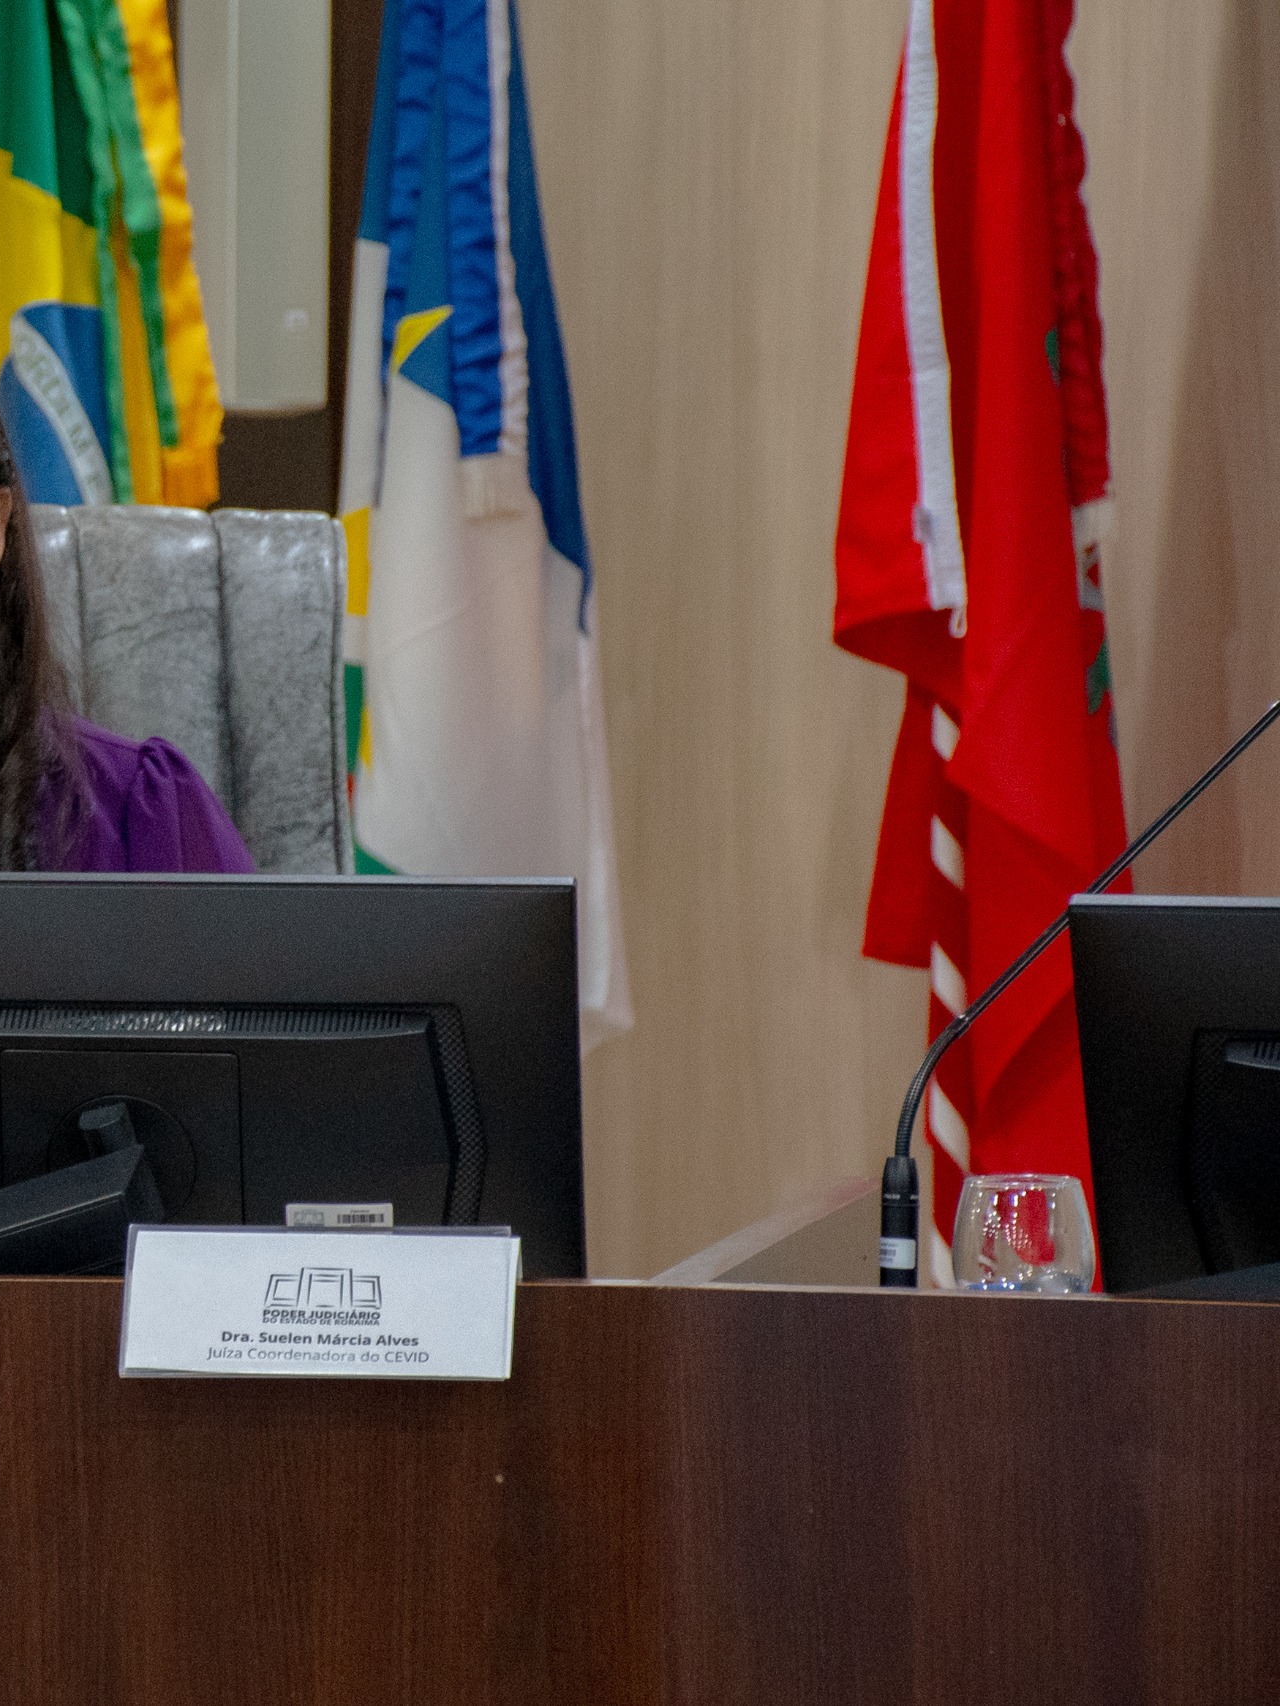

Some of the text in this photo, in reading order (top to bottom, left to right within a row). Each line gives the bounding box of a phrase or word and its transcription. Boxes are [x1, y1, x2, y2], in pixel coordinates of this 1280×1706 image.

[262, 1309, 381, 1320] PODER JUDICIÁRIO
[334, 1318, 380, 1326] RORAIMA
[221, 1331, 419, 1347] Dra. Suelen Márcia Alves
[207, 1346, 430, 1363] Juíza Coordenadora do CEVID
